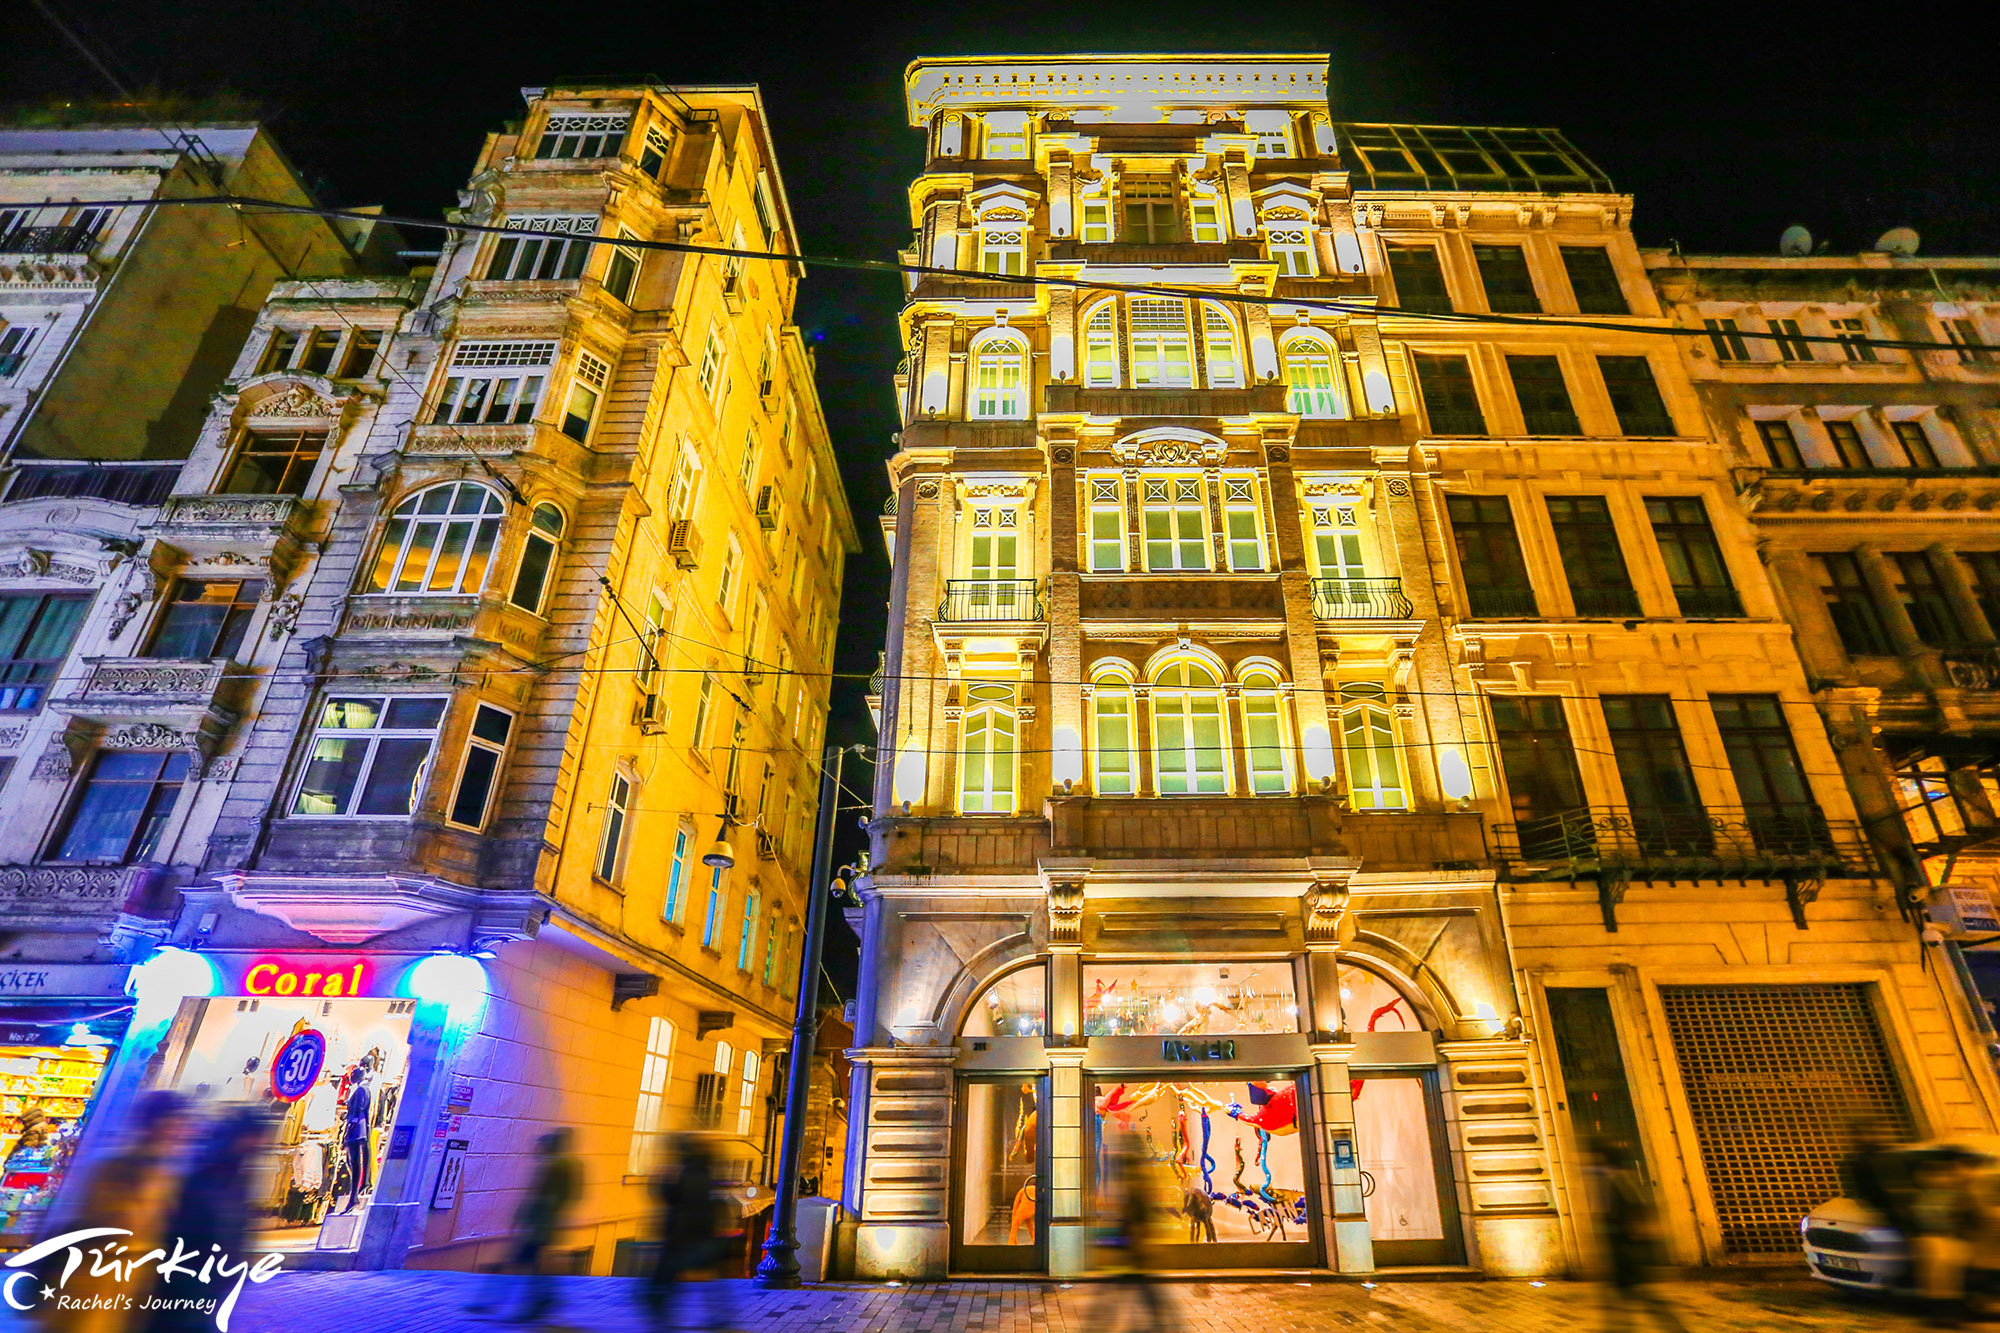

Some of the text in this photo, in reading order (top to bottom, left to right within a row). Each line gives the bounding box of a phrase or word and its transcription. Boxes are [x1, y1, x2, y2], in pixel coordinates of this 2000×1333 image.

[0, 970, 49, 991] ÇİÇEK
[246, 963, 364, 996] Coral
[9, 1032, 40, 1042] No: 27
[284, 1048, 315, 1082] 30
